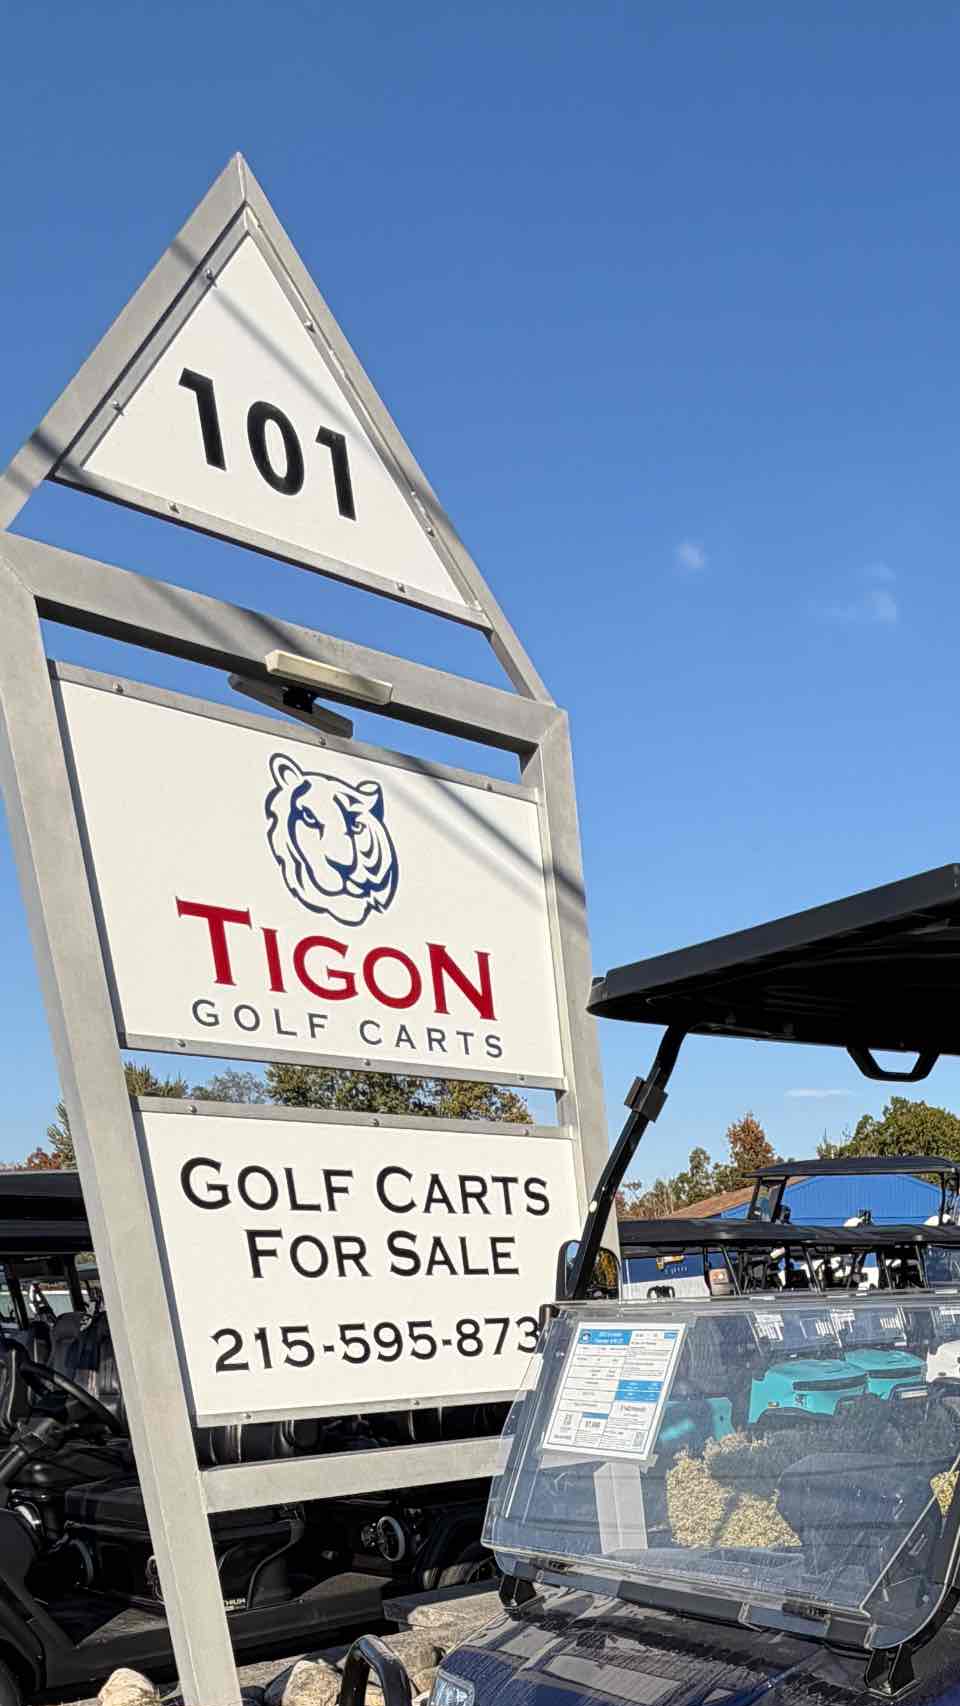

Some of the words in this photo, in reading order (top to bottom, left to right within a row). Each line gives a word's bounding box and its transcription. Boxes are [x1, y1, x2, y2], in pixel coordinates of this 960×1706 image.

[178, 368, 356, 521] 101
[176, 899, 498, 1020] TIGON
[191, 999, 329, 1039] GOLF
[359, 1019, 504, 1059] CARTS
[180, 1157, 354, 1212] GOLF
[376, 1165, 551, 1216] CARTS
[245, 1229, 371, 1279] FOR
[387, 1230, 520, 1277] SALE
